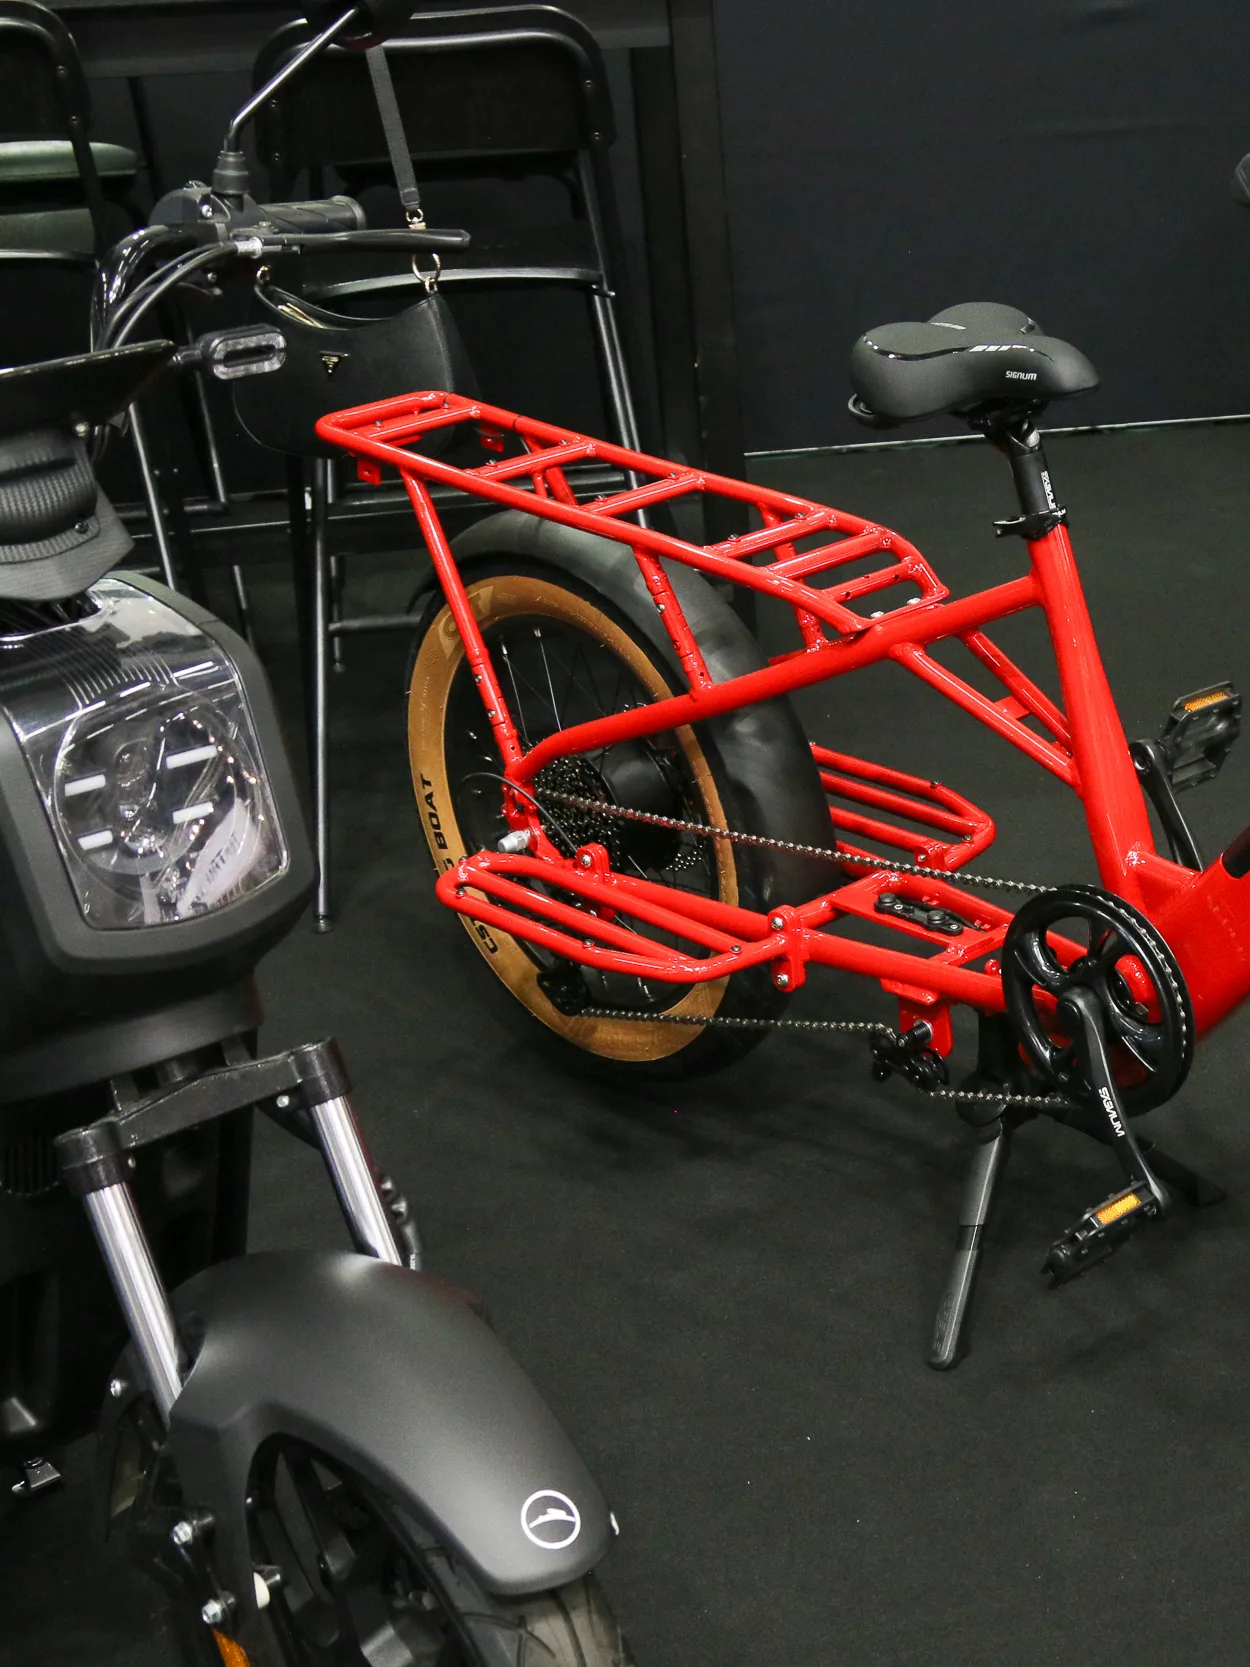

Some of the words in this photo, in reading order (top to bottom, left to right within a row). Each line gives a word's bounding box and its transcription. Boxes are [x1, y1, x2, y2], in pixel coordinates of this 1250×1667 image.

[1005, 370, 1037, 380] SIGNUM
[1041, 470, 1057, 510] SIGNU
[420, 772, 449, 850] BOAT
[470, 915, 499, 954] CS
[1098, 1086, 1126, 1137] SIGNUM
